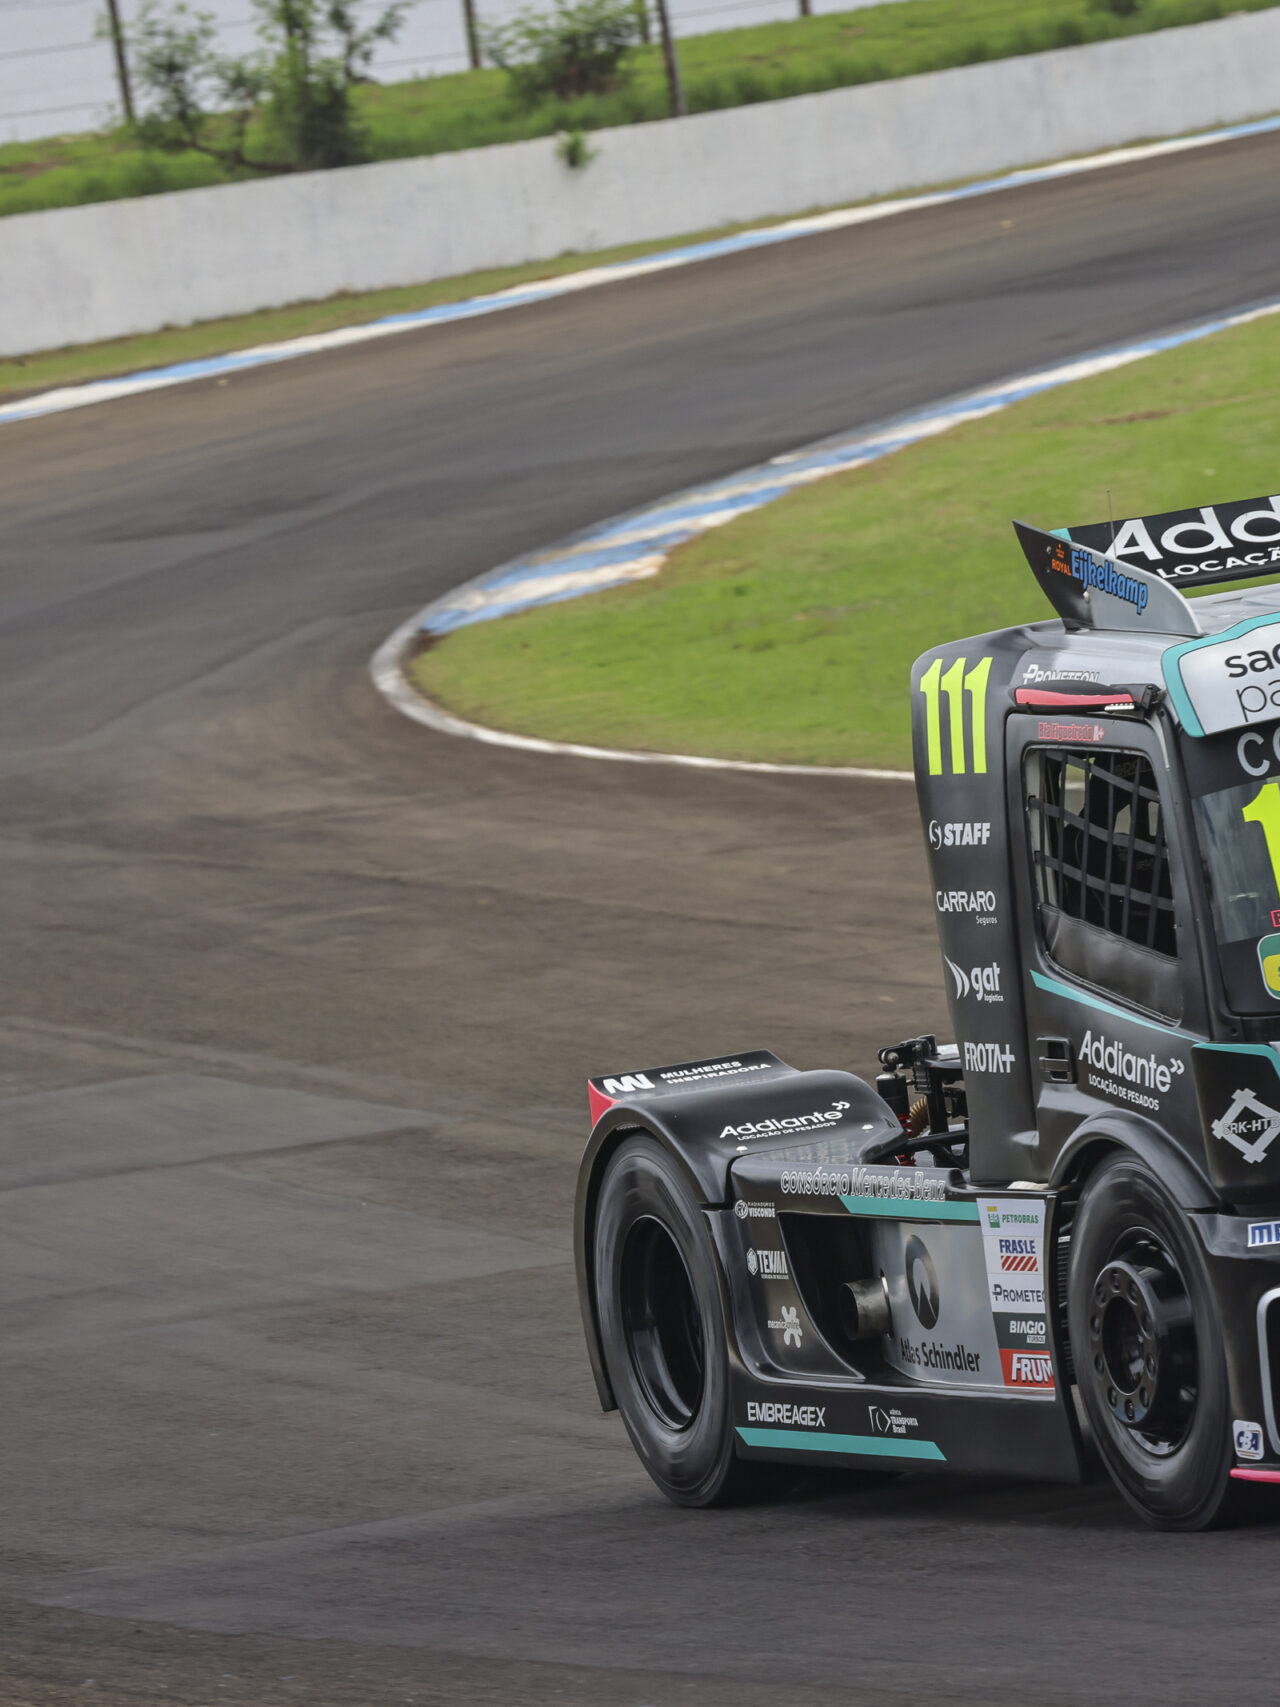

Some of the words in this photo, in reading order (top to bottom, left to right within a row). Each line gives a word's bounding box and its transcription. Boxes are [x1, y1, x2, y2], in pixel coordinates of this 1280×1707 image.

[1051, 558, 1073, 577] ROYAL
[1071, 549, 1148, 615] Eijkelkamp
[920, 656, 993, 776] 111
[943, 822, 991, 846] STAFF
[936, 890, 996, 912] CARRARO
[975, 915, 997, 926] Seguros
[970, 962, 1000, 1001] gat
[659, 1060, 742, 1080] MULHERES
[1078, 1030, 1171, 1093] Addiante
[1088, 1073, 1118, 1096] LOCAÇÃO
[1118, 1086, 1127, 1099] DE
[1127, 1089, 1159, 1111] PESADOS
[719, 1110, 843, 1138] Addiante
[795, 1121, 837, 1132] PESADOS
[780, 1167, 849, 1196] CONSÓRCIO
[851, 1167, 947, 1203] Mercedes-Benz
[748, 1207, 775, 1218] VISCONDE
[1002, 1214, 1039, 1224] PETROBRAS
[1009, 1320, 1046, 1335] BIAGIO
[921, 1342, 980, 1372] Schindler
[746, 1401, 826, 1427] EMBREAGEX
